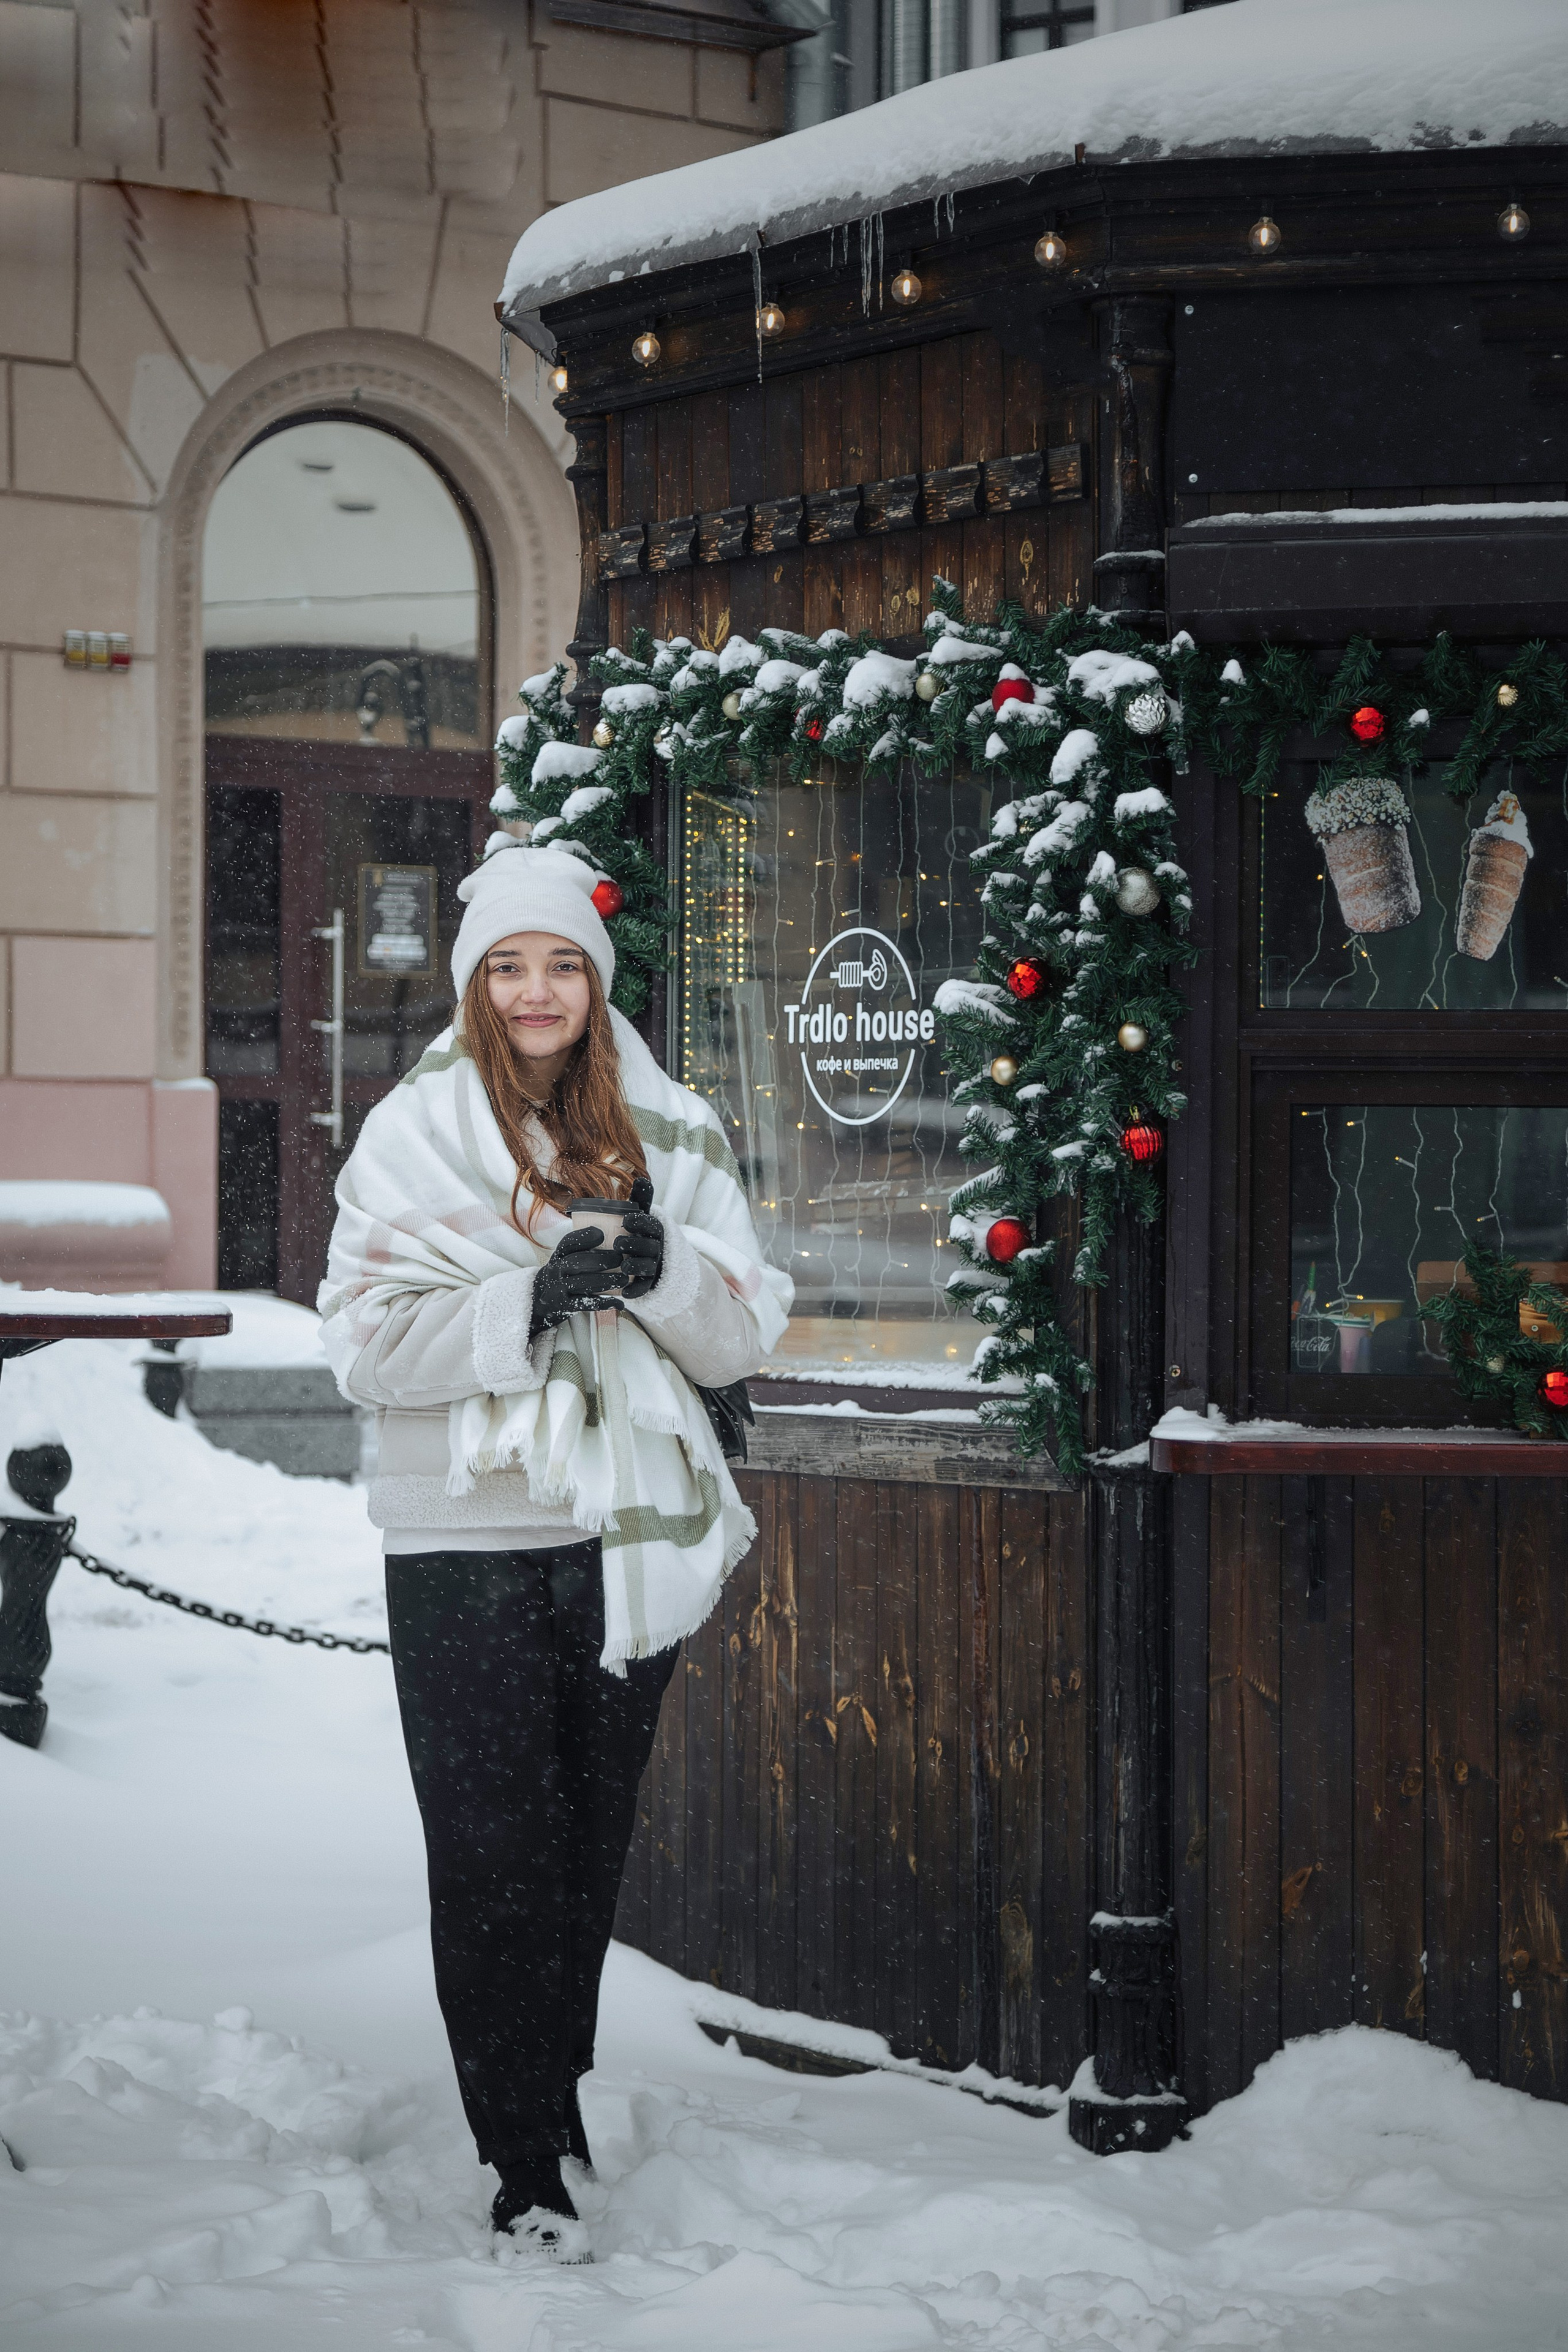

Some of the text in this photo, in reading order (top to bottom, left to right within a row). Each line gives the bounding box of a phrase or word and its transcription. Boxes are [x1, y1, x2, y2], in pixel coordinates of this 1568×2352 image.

[784, 1003, 935, 1044] Trdlo house
[816, 1055, 899, 1075] кофе и выпечка
